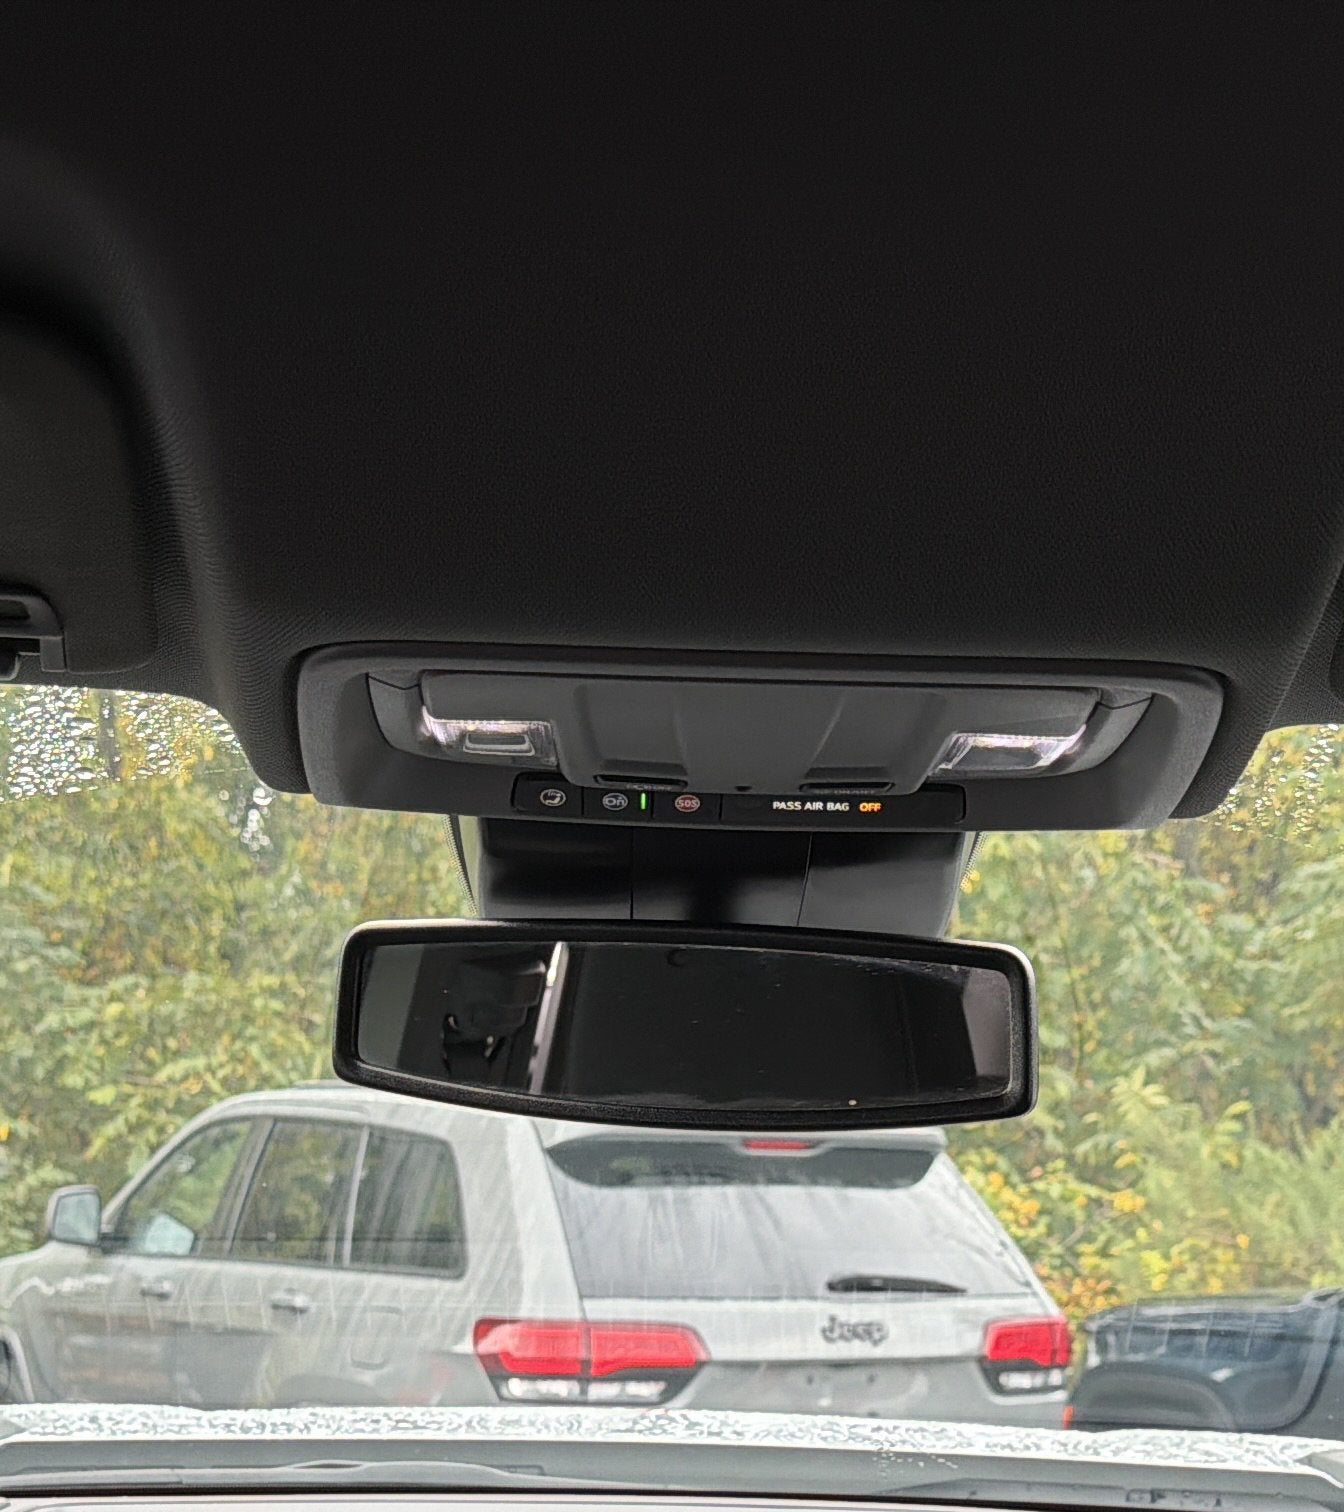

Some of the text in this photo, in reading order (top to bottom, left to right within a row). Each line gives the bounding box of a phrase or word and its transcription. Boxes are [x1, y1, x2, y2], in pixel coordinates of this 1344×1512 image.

[677, 798, 698, 809] SOS
[773, 801, 881, 812] PASS AIR BAG OFF
